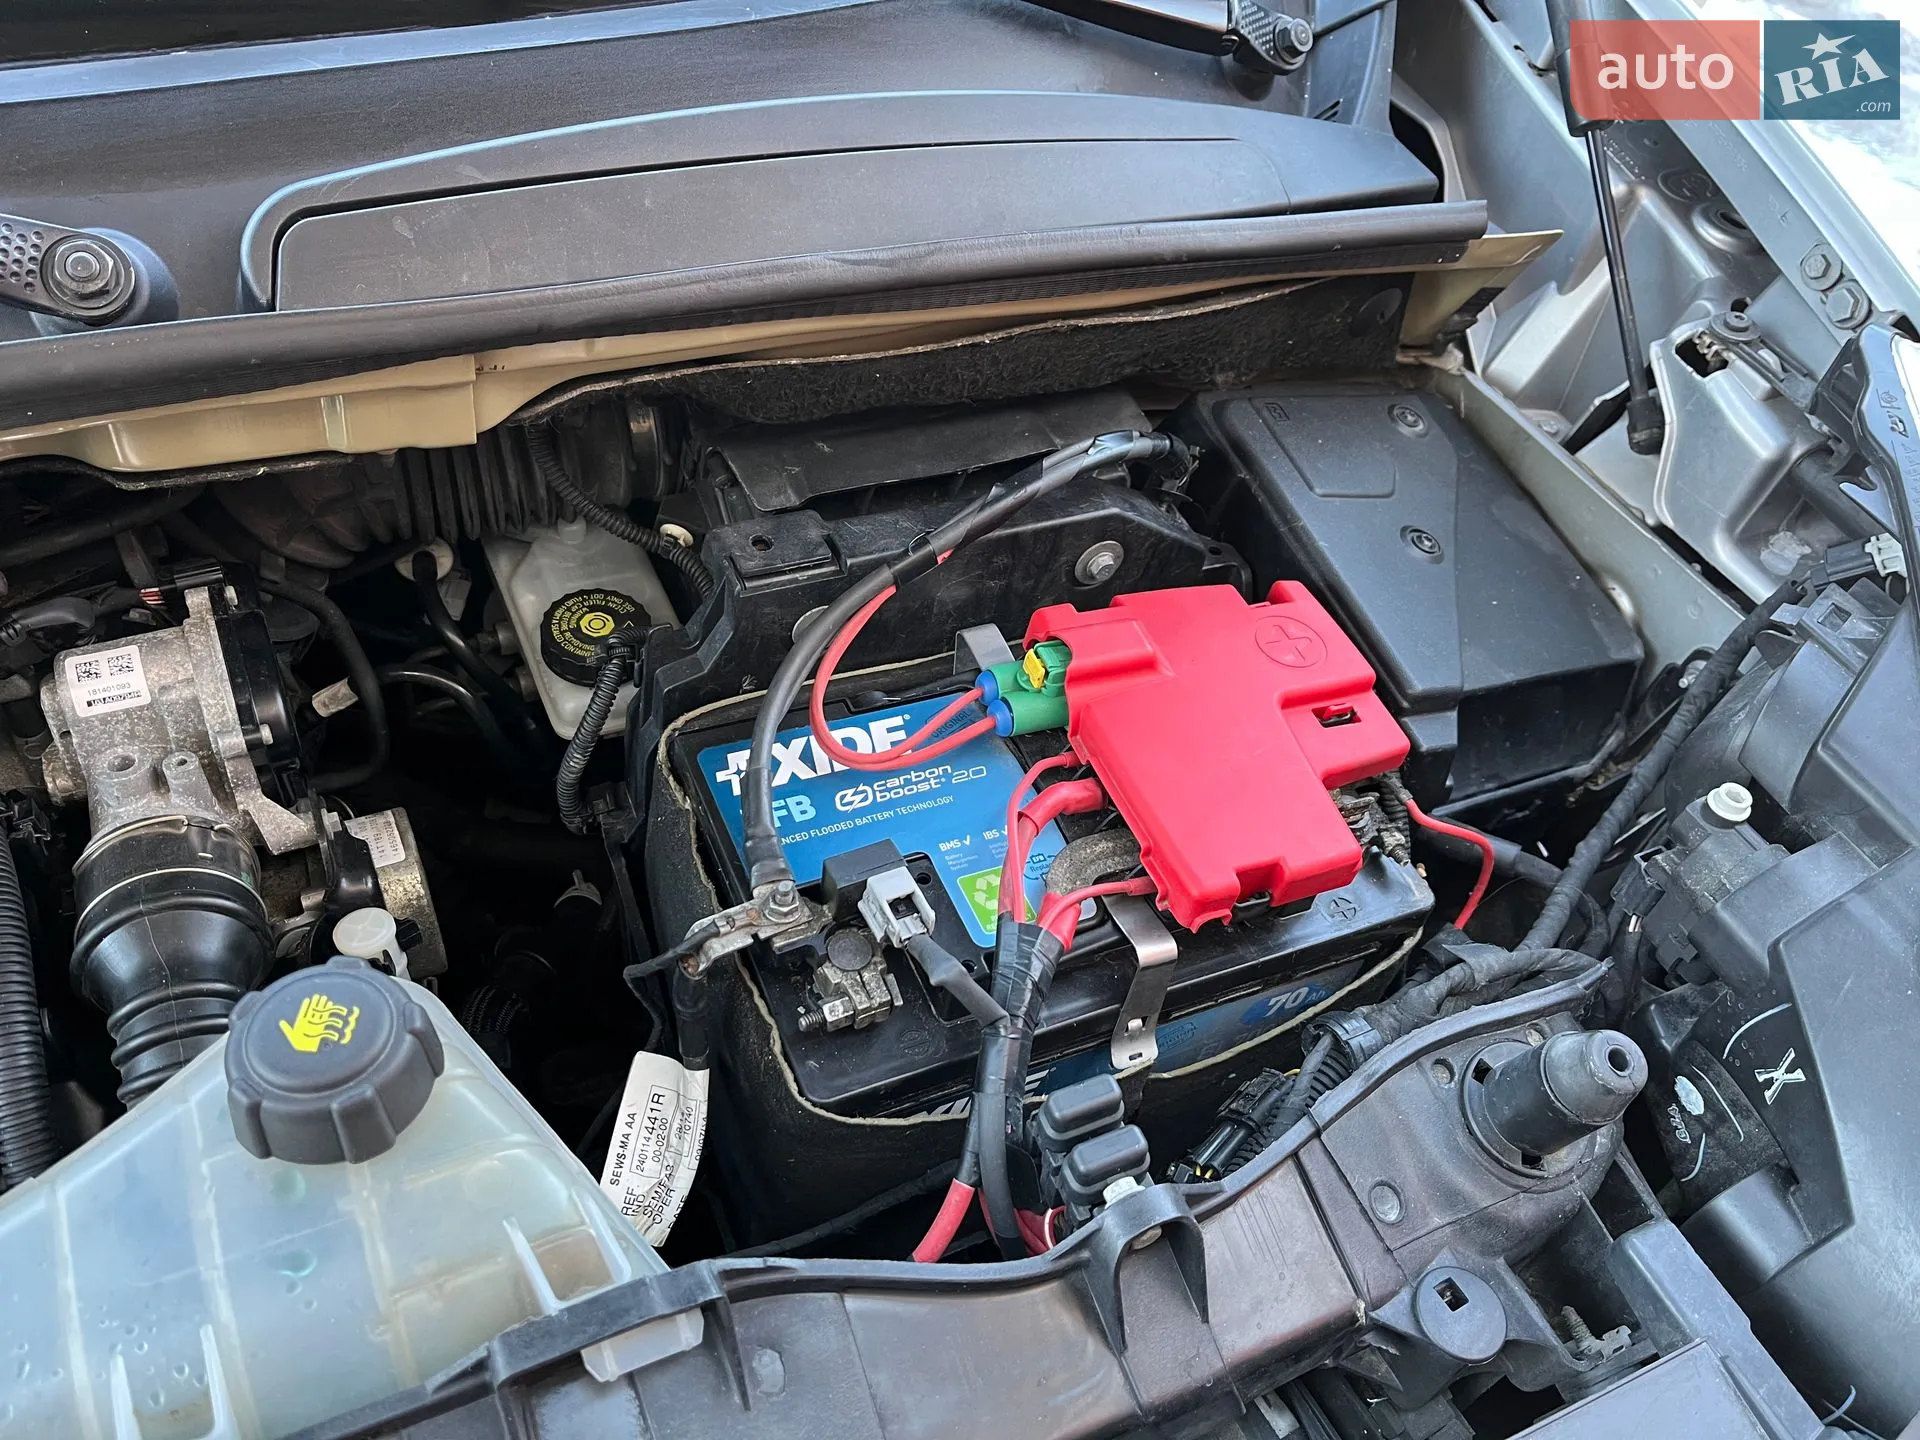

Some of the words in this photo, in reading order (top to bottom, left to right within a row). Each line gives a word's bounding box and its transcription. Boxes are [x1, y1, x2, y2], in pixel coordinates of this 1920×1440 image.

[560, 640, 595, 657] CONTAINE
[873, 765, 952, 791] carbon
[951, 765, 987, 784] 2.0
[769, 794, 817, 828] FB
[810, 820, 855, 838] FLOODED
[855, 809, 895, 826] BATTERY
[895, 794, 955, 815] TECHNOLOGY
[938, 839, 961, 852] BMS
[982, 829, 1000, 840] IBS
[1264, 986, 1309, 1018] 70
[609, 1132, 631, 1186] SEWS-MA
[625, 1112, 638, 1130] AA
[635, 1092, 666, 1173] 240114441R
[651, 1117, 669, 1163] 00-02-00
[652, 1188, 676, 1225] OPER
